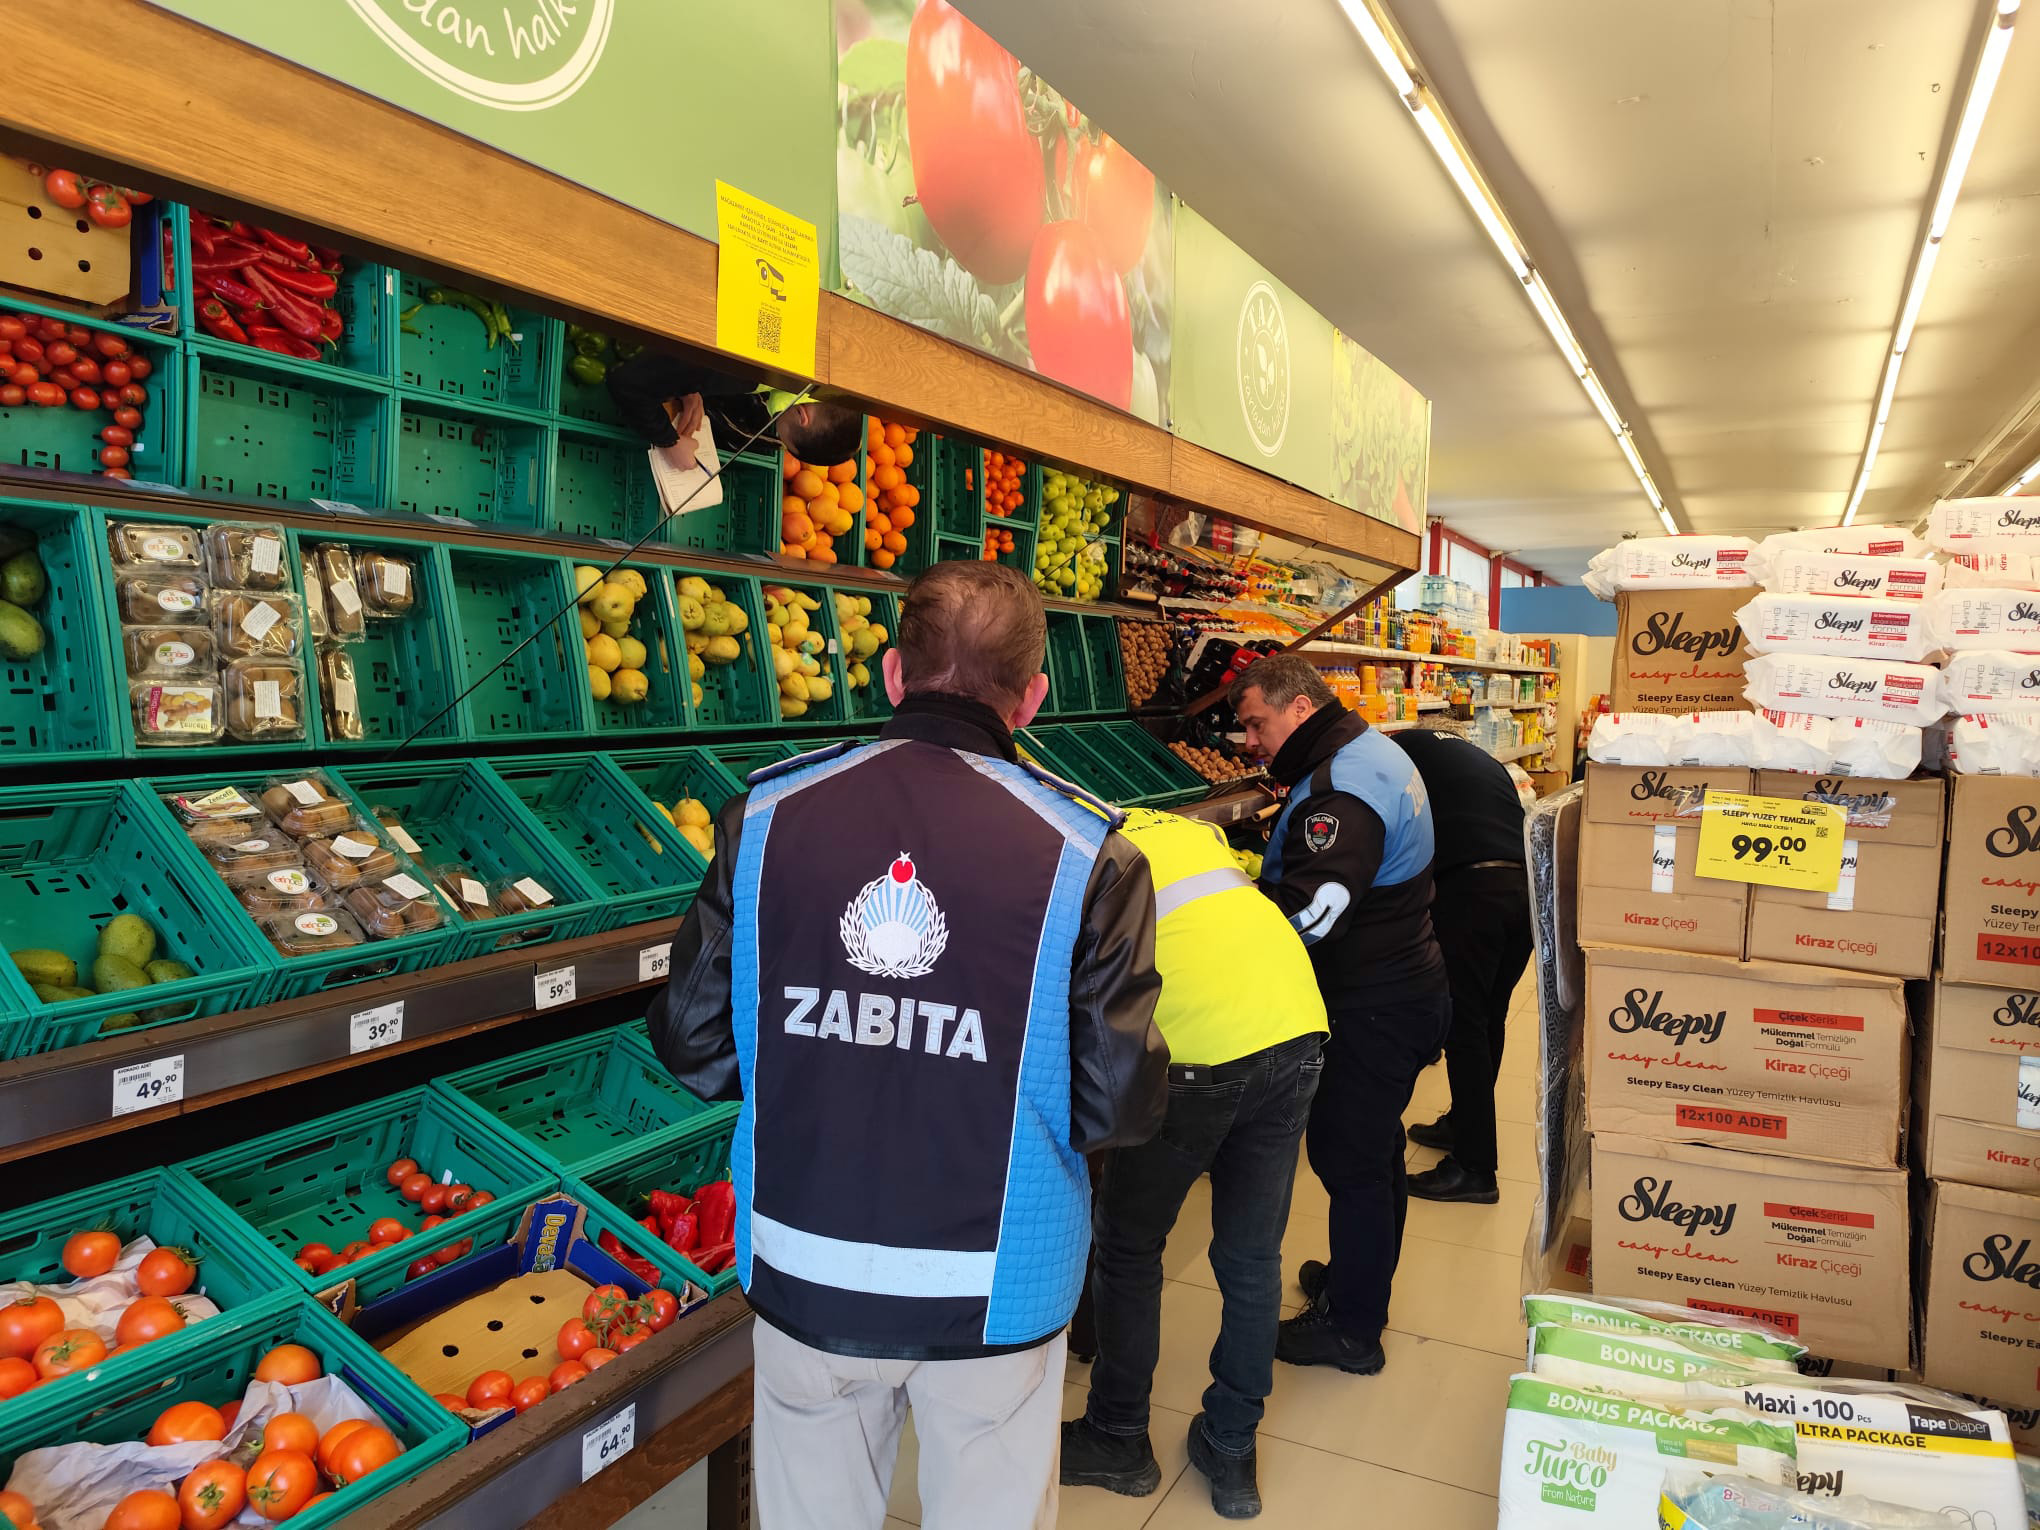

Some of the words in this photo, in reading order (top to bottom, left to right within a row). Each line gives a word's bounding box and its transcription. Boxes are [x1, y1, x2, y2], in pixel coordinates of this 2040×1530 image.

[1671, 553, 1711, 570] Sleepy
[1833, 569, 1881, 592] Sleepy
[1814, 611, 1864, 633] Sleepy
[1632, 611, 1742, 661] Sleepy
[1630, 669, 1678, 684] easy
[1680, 665, 1743, 679] clean
[1828, 671, 1878, 693] Sleepy
[1637, 694, 1673, 704] Sleepy
[1675, 694, 1701, 704] Easy
[1703, 693, 1734, 702] Clean
[1630, 770, 1709, 807] Sleepy
[1628, 810, 1662, 821] easy
[1722, 809, 1750, 819] SLEEPY
[1780, 815, 1816, 826] TEMIZLIK
[1731, 834, 1807, 862] 99,00
[1777, 854, 1791, 866] TL
[1624, 912, 1660, 927] Kiraz
[1661, 914, 1698, 932] Çiçeği
[1991, 904, 2039, 919] Sleepy
[1983, 917, 2020, 931] Yüzey
[1795, 934, 1835, 949] Kiraz
[1836, 939, 1877, 955] Çiçeği
[784, 986, 988, 1062] ZABITA
[1608, 988, 1727, 1046] Sleepy
[1778, 1011, 1809, 1025] Çiçek
[1809, 1014, 1838, 1025] Serisi
[369, 1018, 399, 1040] 39,90
[1760, 1026, 1815, 1040] Mükemmel
[1775, 1037, 1804, 1049] Doğal
[1608, 1051, 1659, 1068] easy
[1661, 1051, 1728, 1072] clean
[1765, 1058, 1806, 1074] Kiraz
[1808, 1059, 1851, 1081] Çiçeği
[136, 1073, 177, 1099] 49,90
[1627, 1076, 1663, 1089] Sleepy
[1665, 1080, 1690, 1093] Easy
[1692, 1083, 1724, 1095] Clean
[1726, 1086, 1755, 1099] Yüzey
[1757, 1089, 1797, 1103] Temizlik
[1799, 1094, 1841, 1108] Havlusu
[1679, 1108, 1733, 1125] 12x100
[1738, 1115, 1783, 1131] ADET
[1987, 1149, 2030, 1167] Kiraz
[1618, 1176, 1737, 1236] Sleepy
[1789, 1205, 1819, 1219] Çiçek
[1820, 1209, 1848, 1221] Serisi
[1771, 1221, 1826, 1236] Mükemmel
[1787, 1231, 1815, 1244] Doğal
[1618, 1239, 1669, 1259] easy
[1671, 1243, 1739, 1264] clean
[1776, 1253, 1818, 1270] Kiraz
[1820, 1258, 1862, 1278] Çiçeği
[1637, 1266, 1674, 1281] Sleepy
[1675, 1272, 1701, 1285] Easy
[1703, 1276, 1735, 1290] Clean
[1737, 1281, 1767, 1296] Yüzey
[1768, 1285, 1808, 1300] Temizlik
[1809, 1290, 1852, 1307] Havlusu
[1571, 1311, 1641, 1335] BONUS
[1750, 1311, 1795, 1328] ADET
[1958, 1301, 2020, 1323] easy
[1980, 1330, 2023, 1347] Sleepy
[1600, 1344, 1675, 1374] BONUS
[1547, 1391, 1620, 1420] BONUS
[1627, 1407, 1731, 1436] PACKAGE
[1744, 1390, 1796, 1415] Maxi
[1812, 1400, 1854, 1421] 100
[1857, 1414, 1872, 1424] Pcs
[1910, 1415, 1947, 1432] Tape
[1948, 1418, 1988, 1435] Diaper
[1846, 1428, 1927, 1448] PACKAGE
[1524, 1438, 1607, 1488] Turco
[1570, 1441, 1618, 1472] Baby
[1542, 1485, 1564, 1500] From
[1565, 1487, 1595, 1508] Nature
